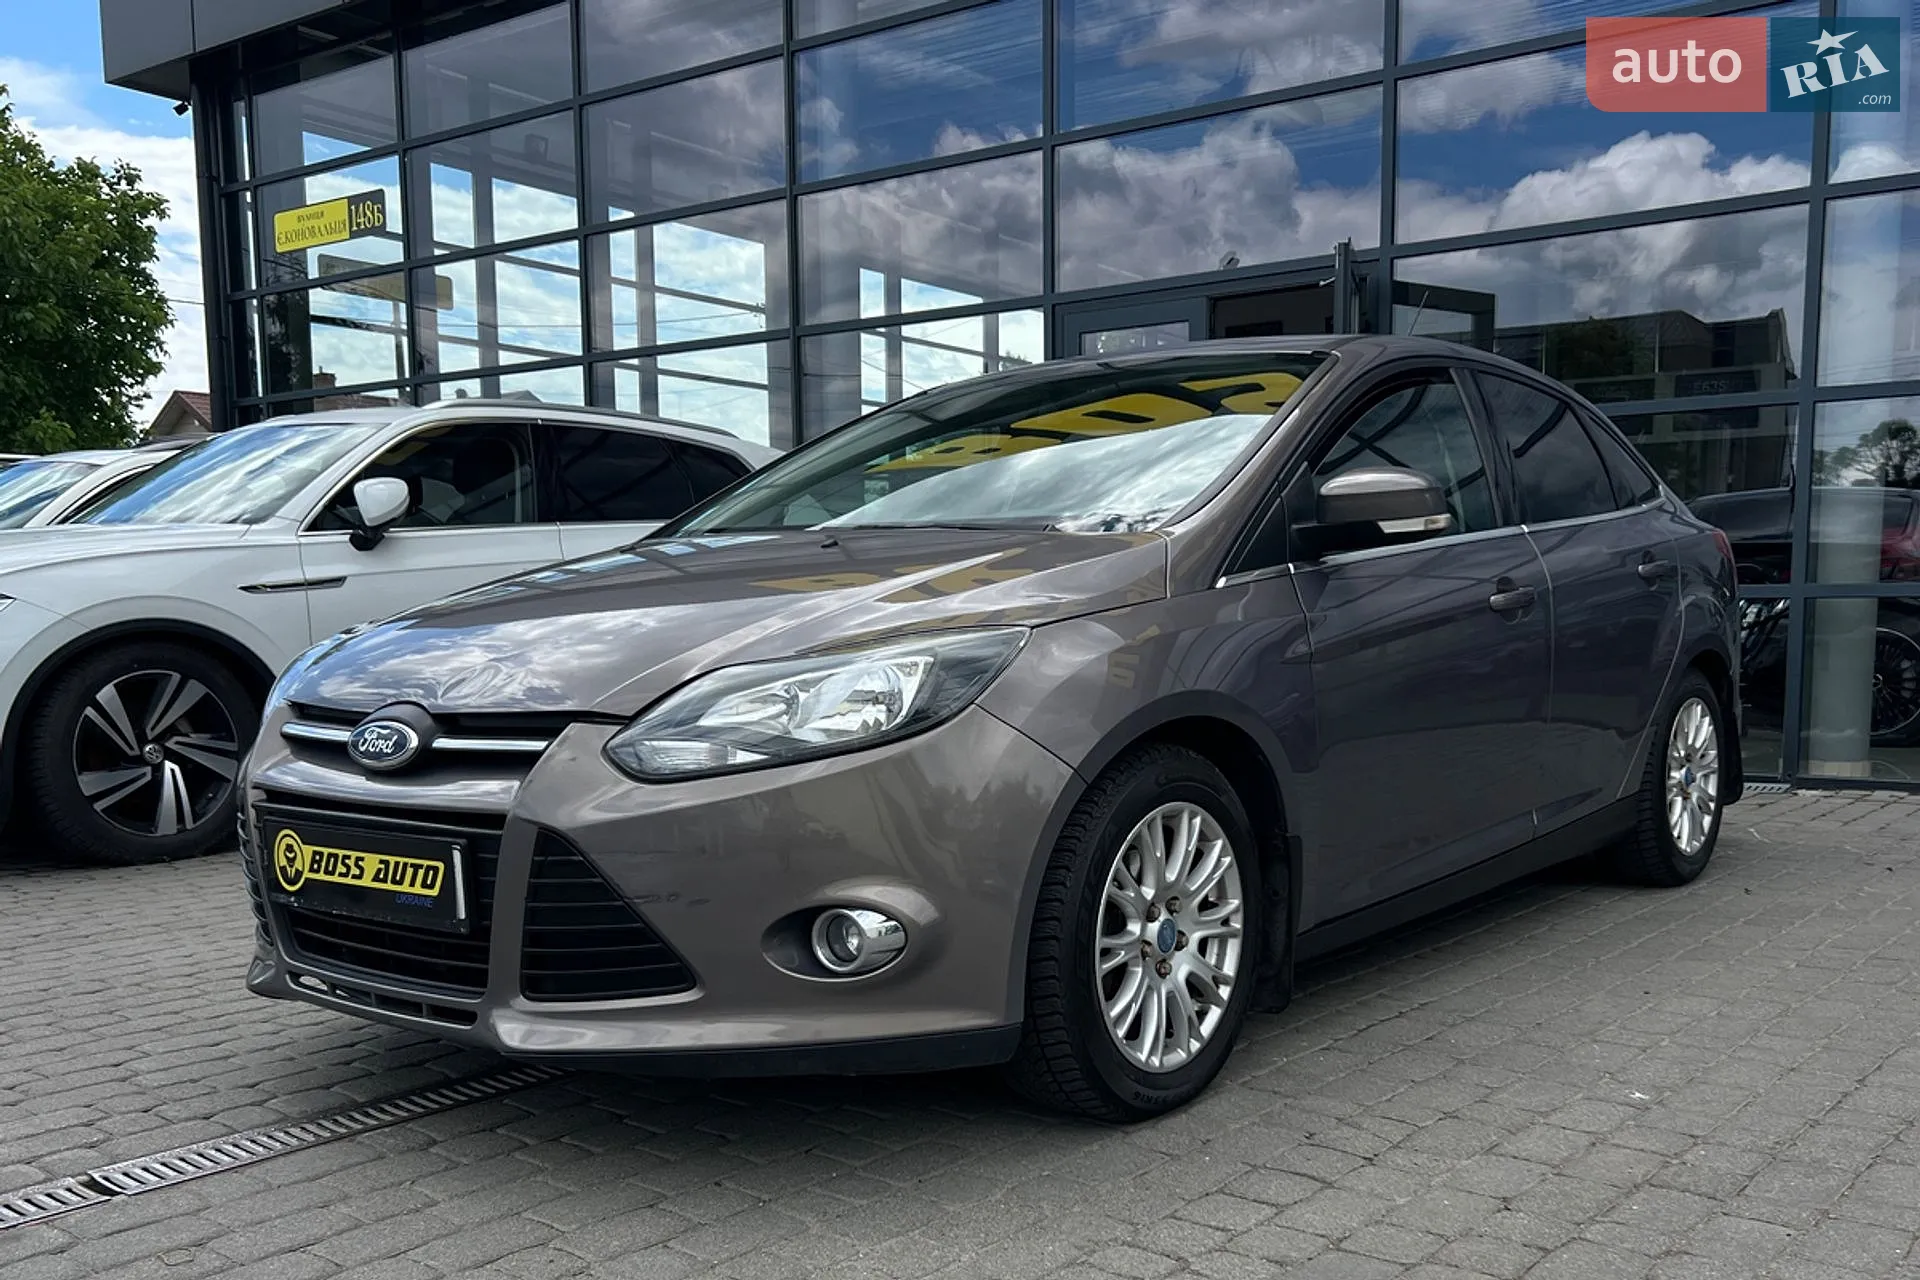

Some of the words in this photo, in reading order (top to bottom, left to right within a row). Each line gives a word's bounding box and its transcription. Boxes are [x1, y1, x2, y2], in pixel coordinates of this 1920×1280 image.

[350, 200, 384, 231] 148Б
[358, 726, 398, 753] Ford
[308, 850, 365, 880] BOSS
[371, 858, 440, 890] AUTO
